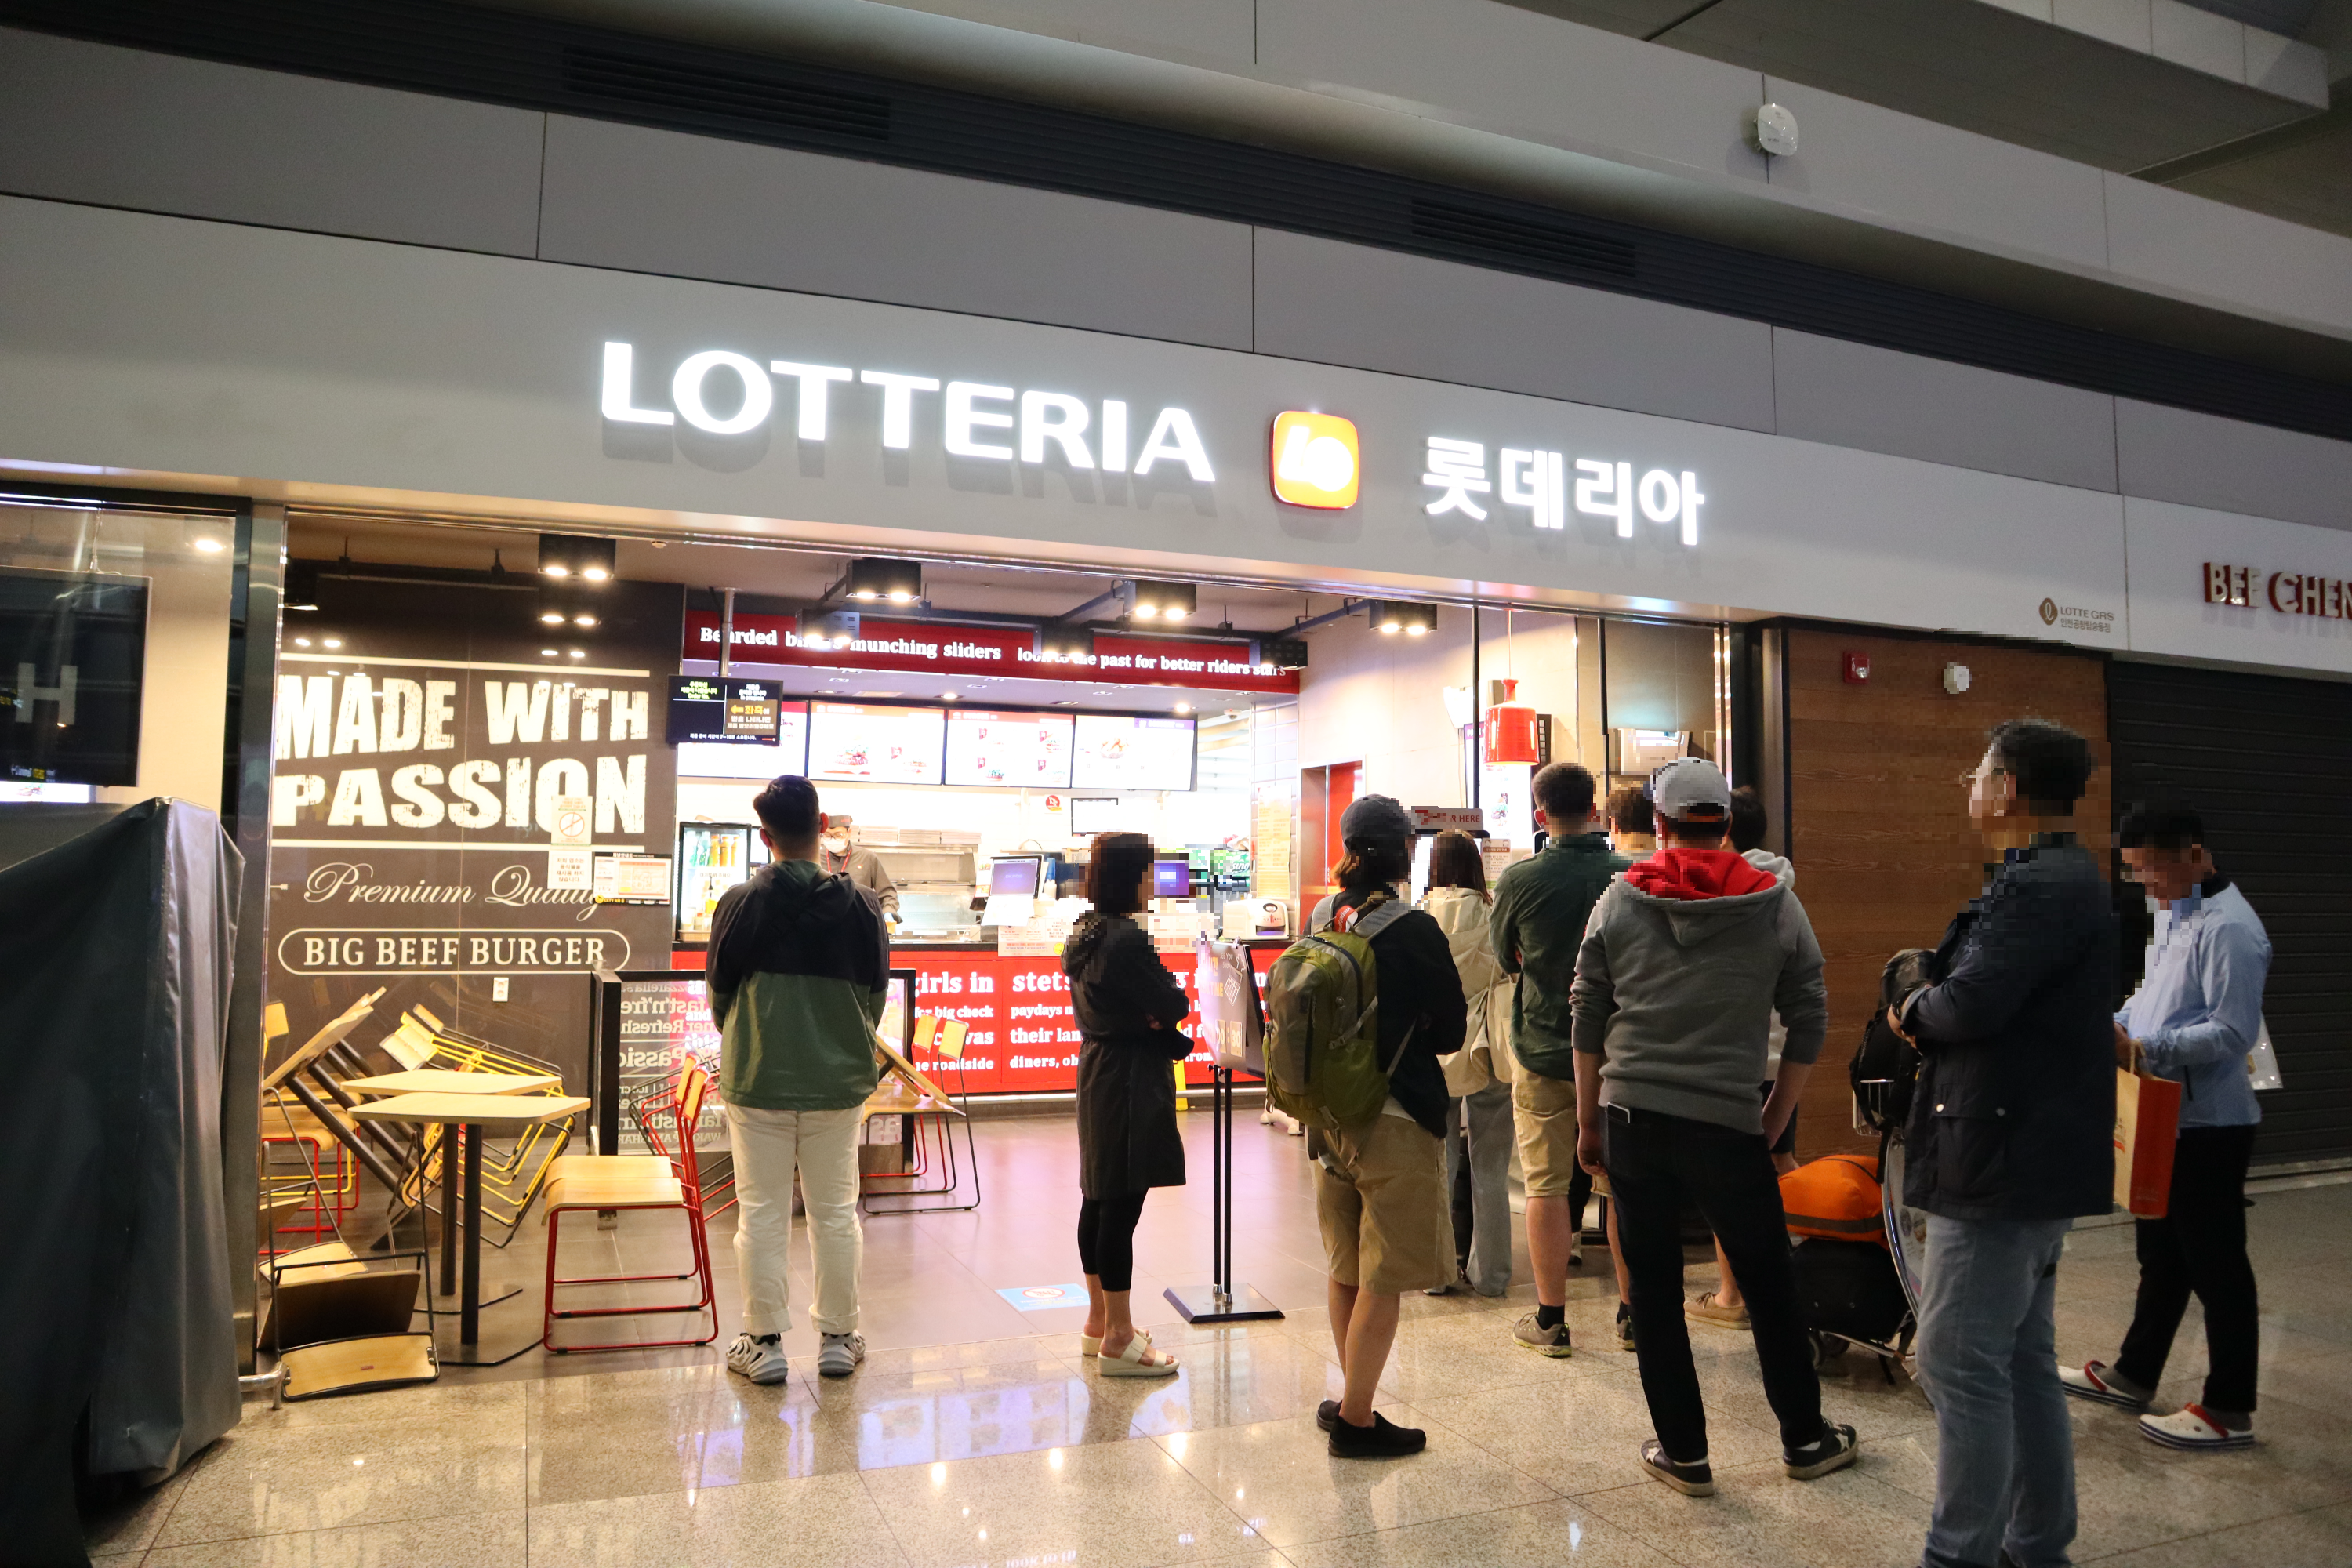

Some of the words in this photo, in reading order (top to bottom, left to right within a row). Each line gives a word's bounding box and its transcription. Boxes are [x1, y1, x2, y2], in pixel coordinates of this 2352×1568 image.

[601, 340, 1217, 483] LOTTERIA
[1422, 437, 1705, 546] 롯데리아
[2204, 562, 2262, 608] BEE
[2060, 607, 2089, 618] LOTTE
[2091, 610, 2115, 621] GRS
[2060, 618, 2111, 633] 인천공항탑승동점
[850, 638, 938, 659] munching
[943, 641, 1002, 660] sliders
[1100, 653, 1132, 670] past
[1135, 653, 1156, 670] for
[1161, 655, 1204, 672] better
[1207, 660, 1250, 675] riders
[274, 674, 456, 760] MADE
[485, 681, 649, 745] WITH
[744, 705, 770, 715] 좌측에
[272, 755, 646, 834] PASSION
[303, 862, 476, 904] Premium
[303, 937, 365, 966] BIG
[376, 937, 459, 966] BEEF
[469, 937, 606, 966] BURGER
[970, 971, 993, 993] in
[935, 1006, 955, 1019] big
[956, 1005, 994, 1018] check
[1011, 1004, 1063, 1019] paydays
[1010, 1027, 1053, 1044] their
[932, 1057, 994, 1071] roadside
[1009, 1055, 1060, 1069] diners,
